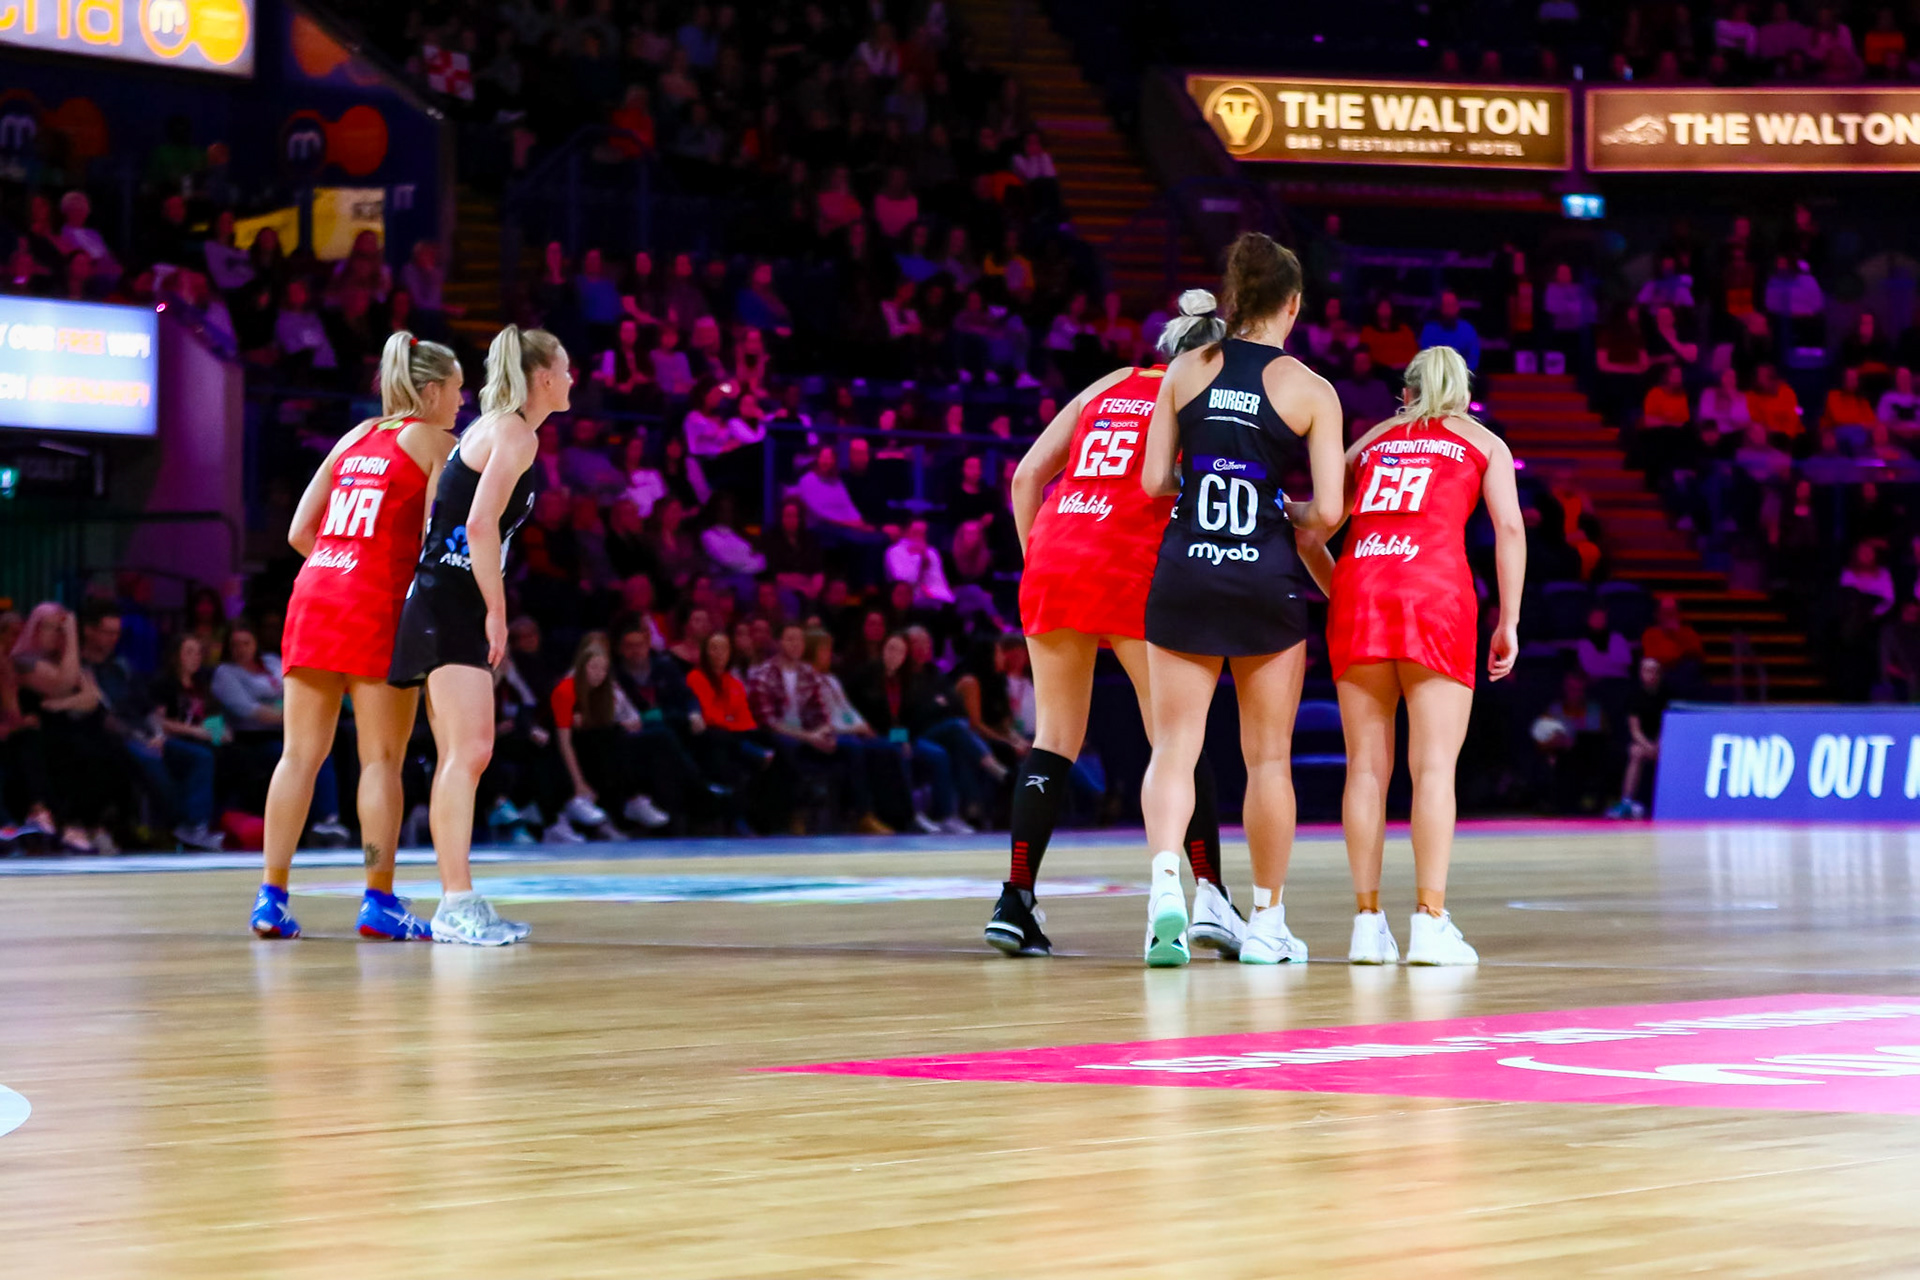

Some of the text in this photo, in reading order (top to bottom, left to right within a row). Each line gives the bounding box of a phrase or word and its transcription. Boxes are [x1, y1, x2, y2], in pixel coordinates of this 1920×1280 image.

[1278, 91, 1550, 135] THE WALTON
[1668, 113, 1920, 145] THE WALTON
[1285, 134, 1525, 156] BAR RESTAURANT HOTEL
[1098, 398, 1157, 416] FISHER
[1208, 388, 1261, 415] BURGER
[339, 455, 391, 475] PITMAN
[1073, 430, 1140, 477] GS
[1198, 473, 1259, 535] GD
[1360, 465, 1433, 513] GA
[322, 489, 384, 537] WA
[1057, 491, 1113, 521] Vitality
[308, 547, 359, 575] Vitality
[1188, 542, 1260, 566] myob
[1354, 532, 1420, 562] Vitality
[1704, 733, 1796, 800] FIND
[1807, 733, 1896, 800] OUT
